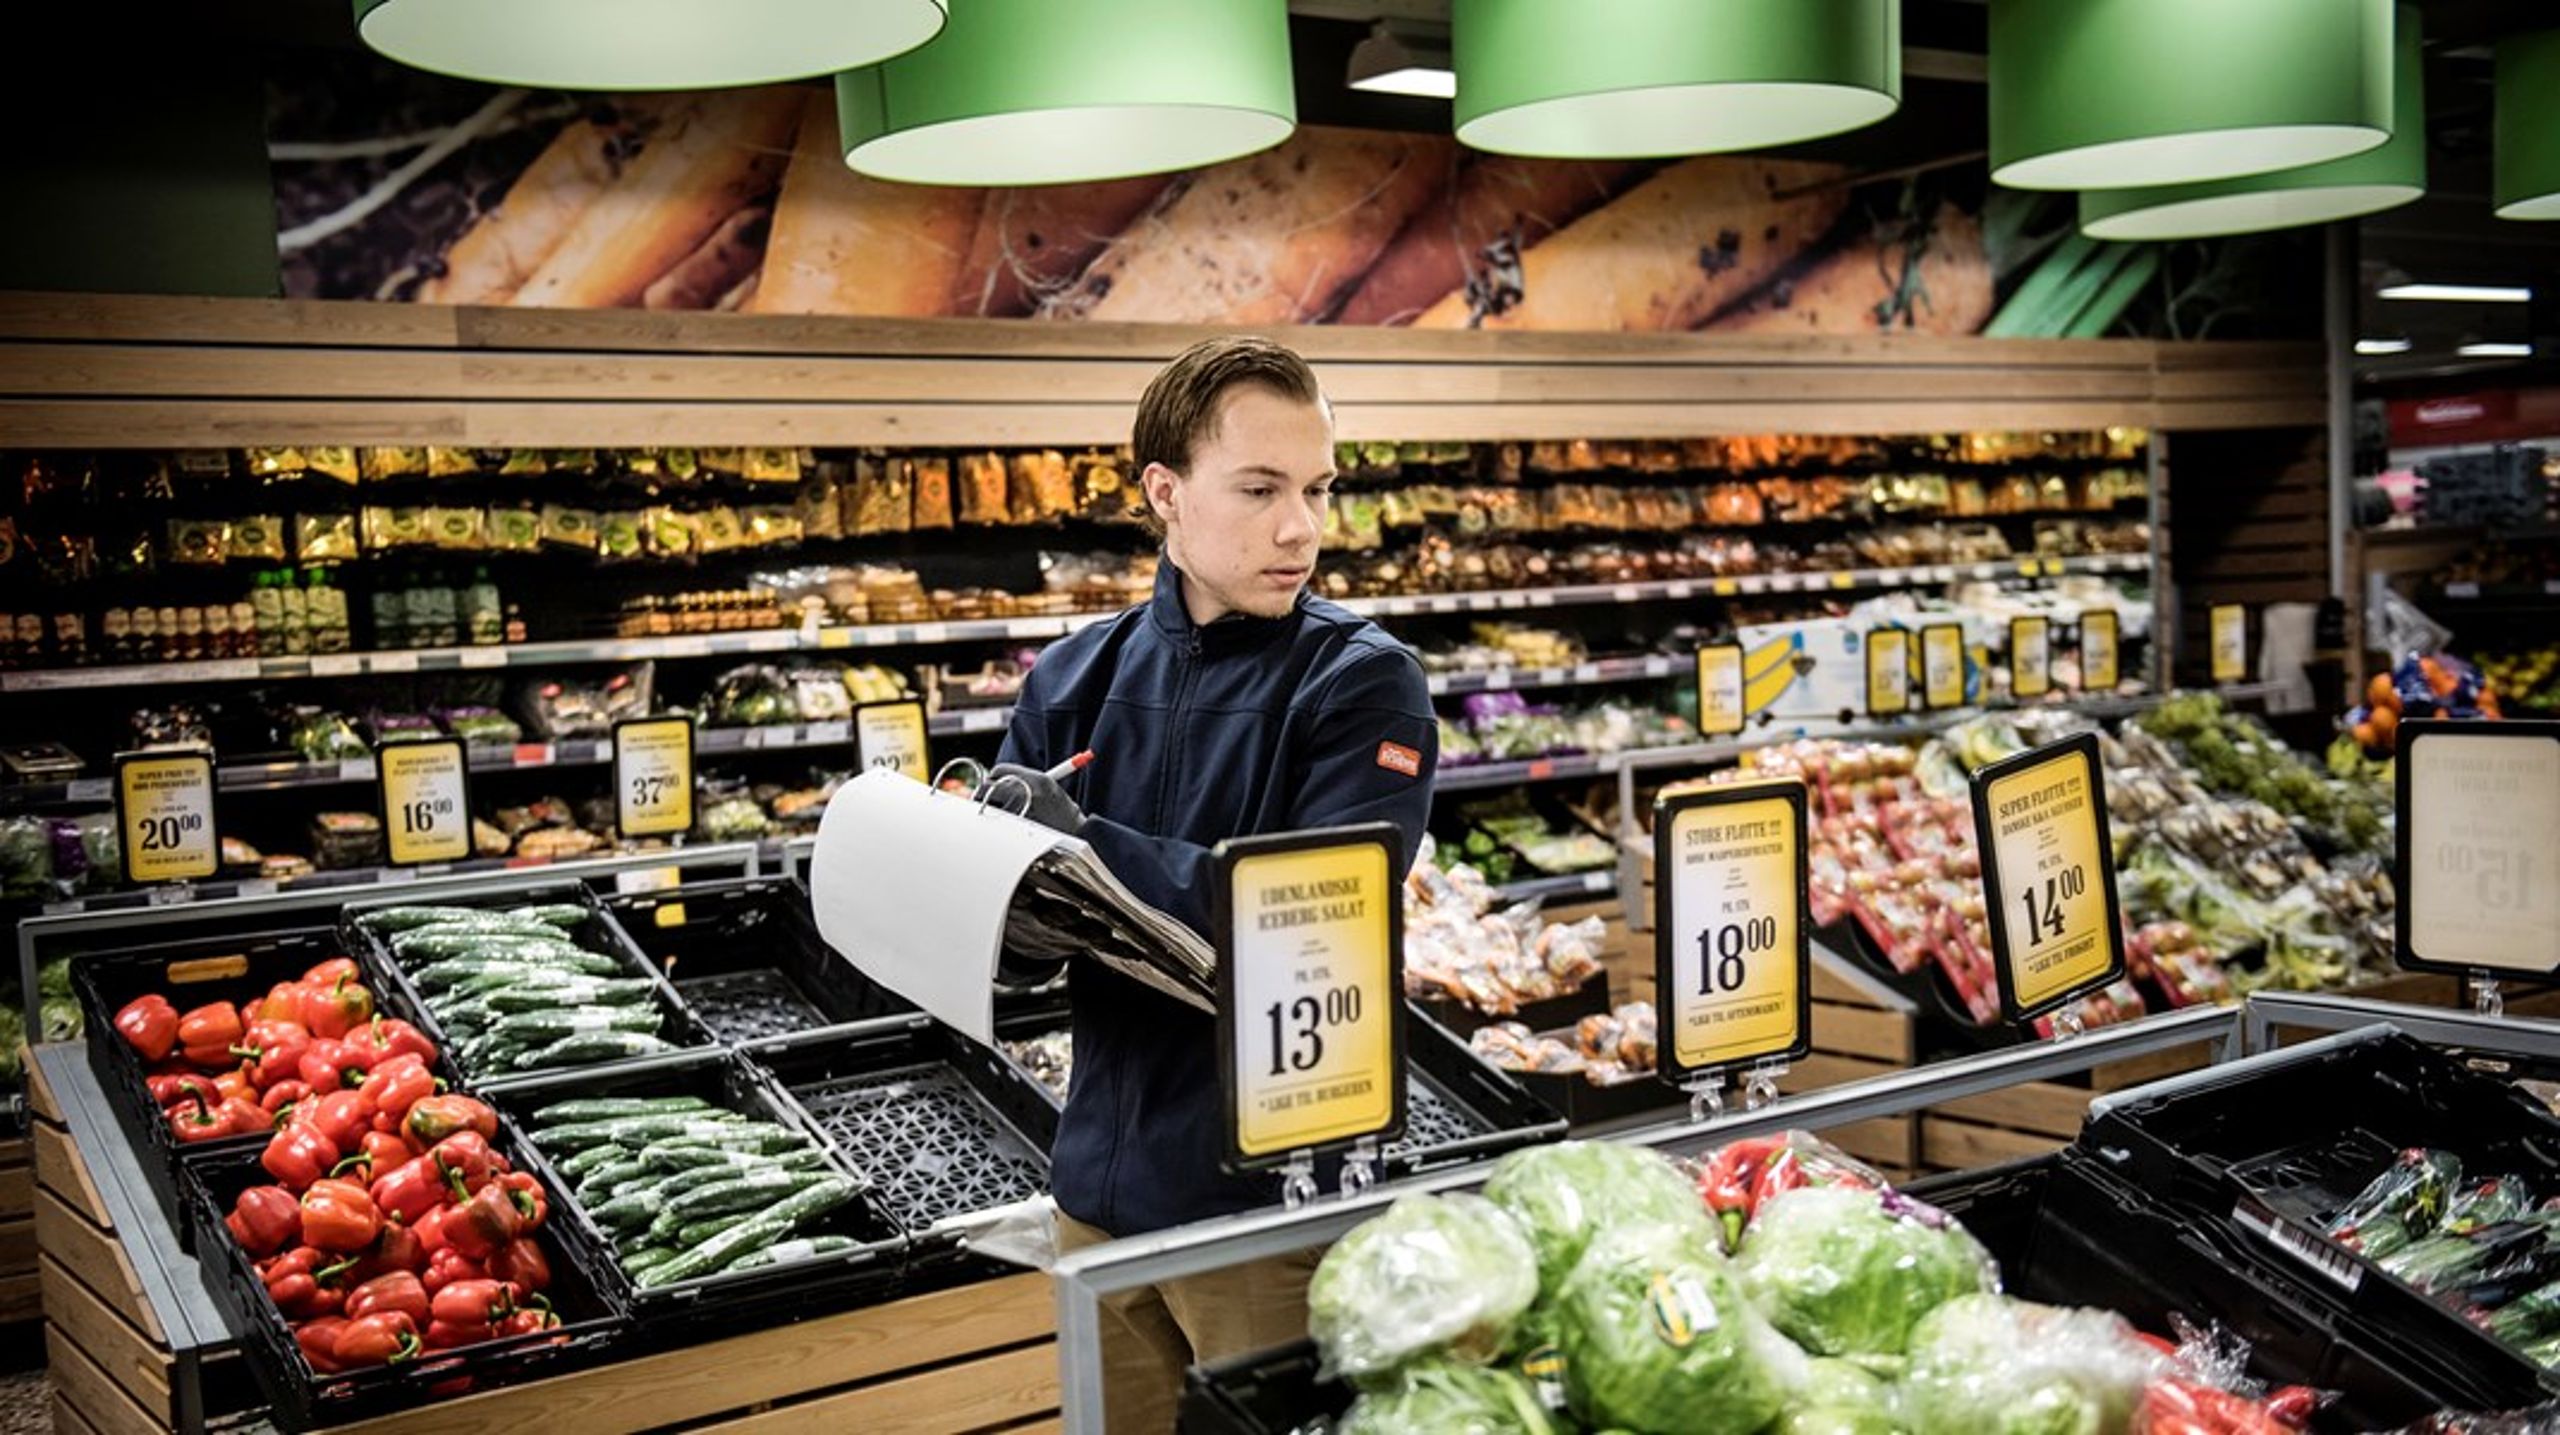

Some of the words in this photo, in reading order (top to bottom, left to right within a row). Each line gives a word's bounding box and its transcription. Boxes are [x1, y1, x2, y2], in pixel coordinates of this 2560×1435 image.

[1999, 794, 2031, 819] SUPER
[2031, 780, 2067, 807] FLOTTE
[1686, 827, 1722, 846] STORE
[1725, 821, 1766, 842] FLOTTE
[1260, 876, 1362, 907] UDENLANDSKE
[1258, 906, 1318, 931] ICEBERG
[1322, 900, 1365, 922] SALAT
